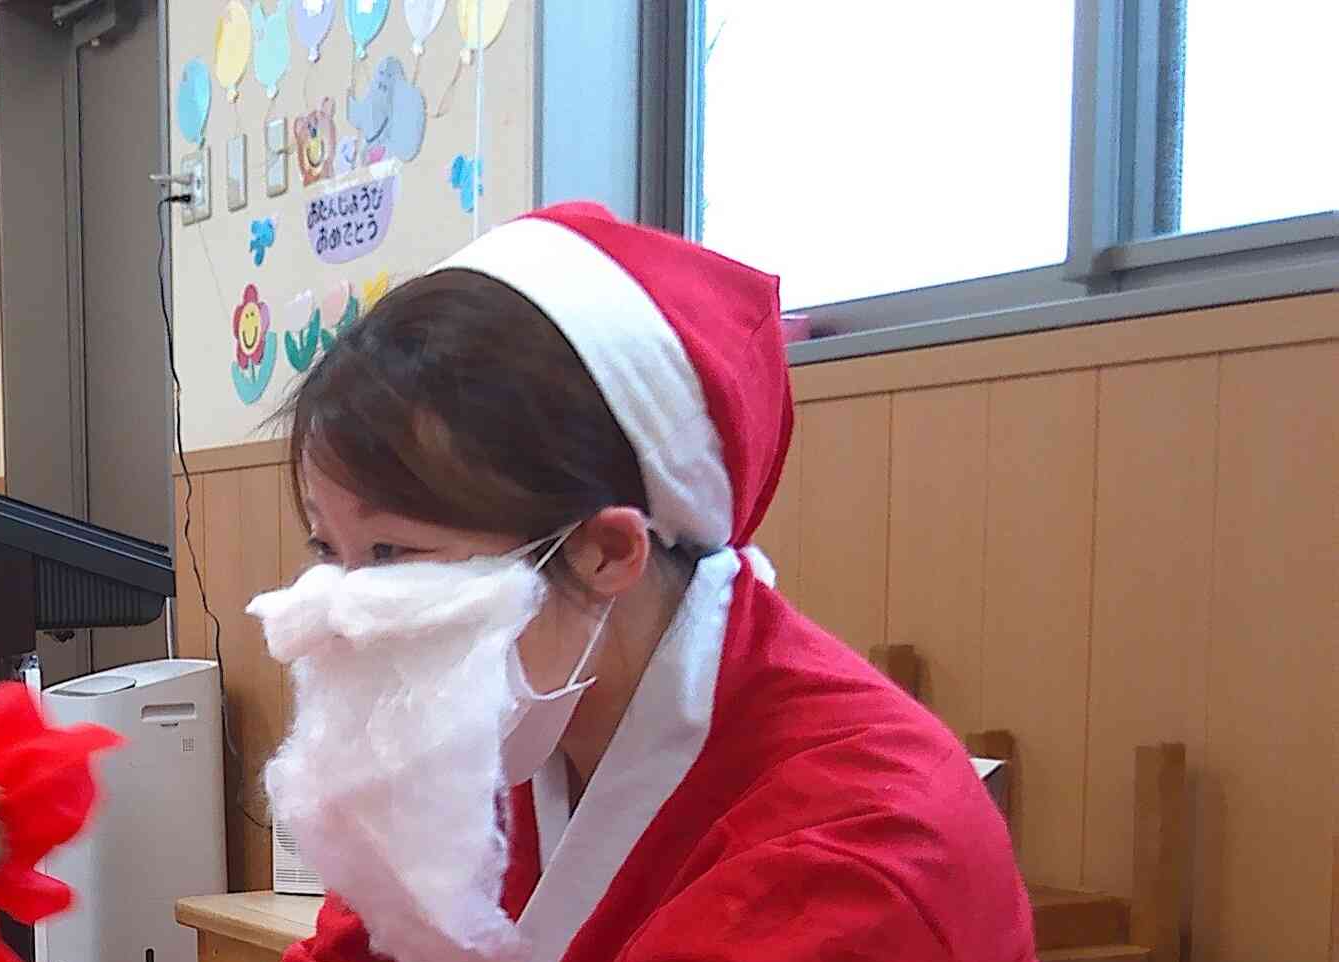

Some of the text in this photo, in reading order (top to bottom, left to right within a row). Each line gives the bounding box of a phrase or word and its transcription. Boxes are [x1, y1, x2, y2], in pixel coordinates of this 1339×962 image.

[307, 185, 383, 229] おたんじょうび
[316, 213, 378, 254] おめでとう
